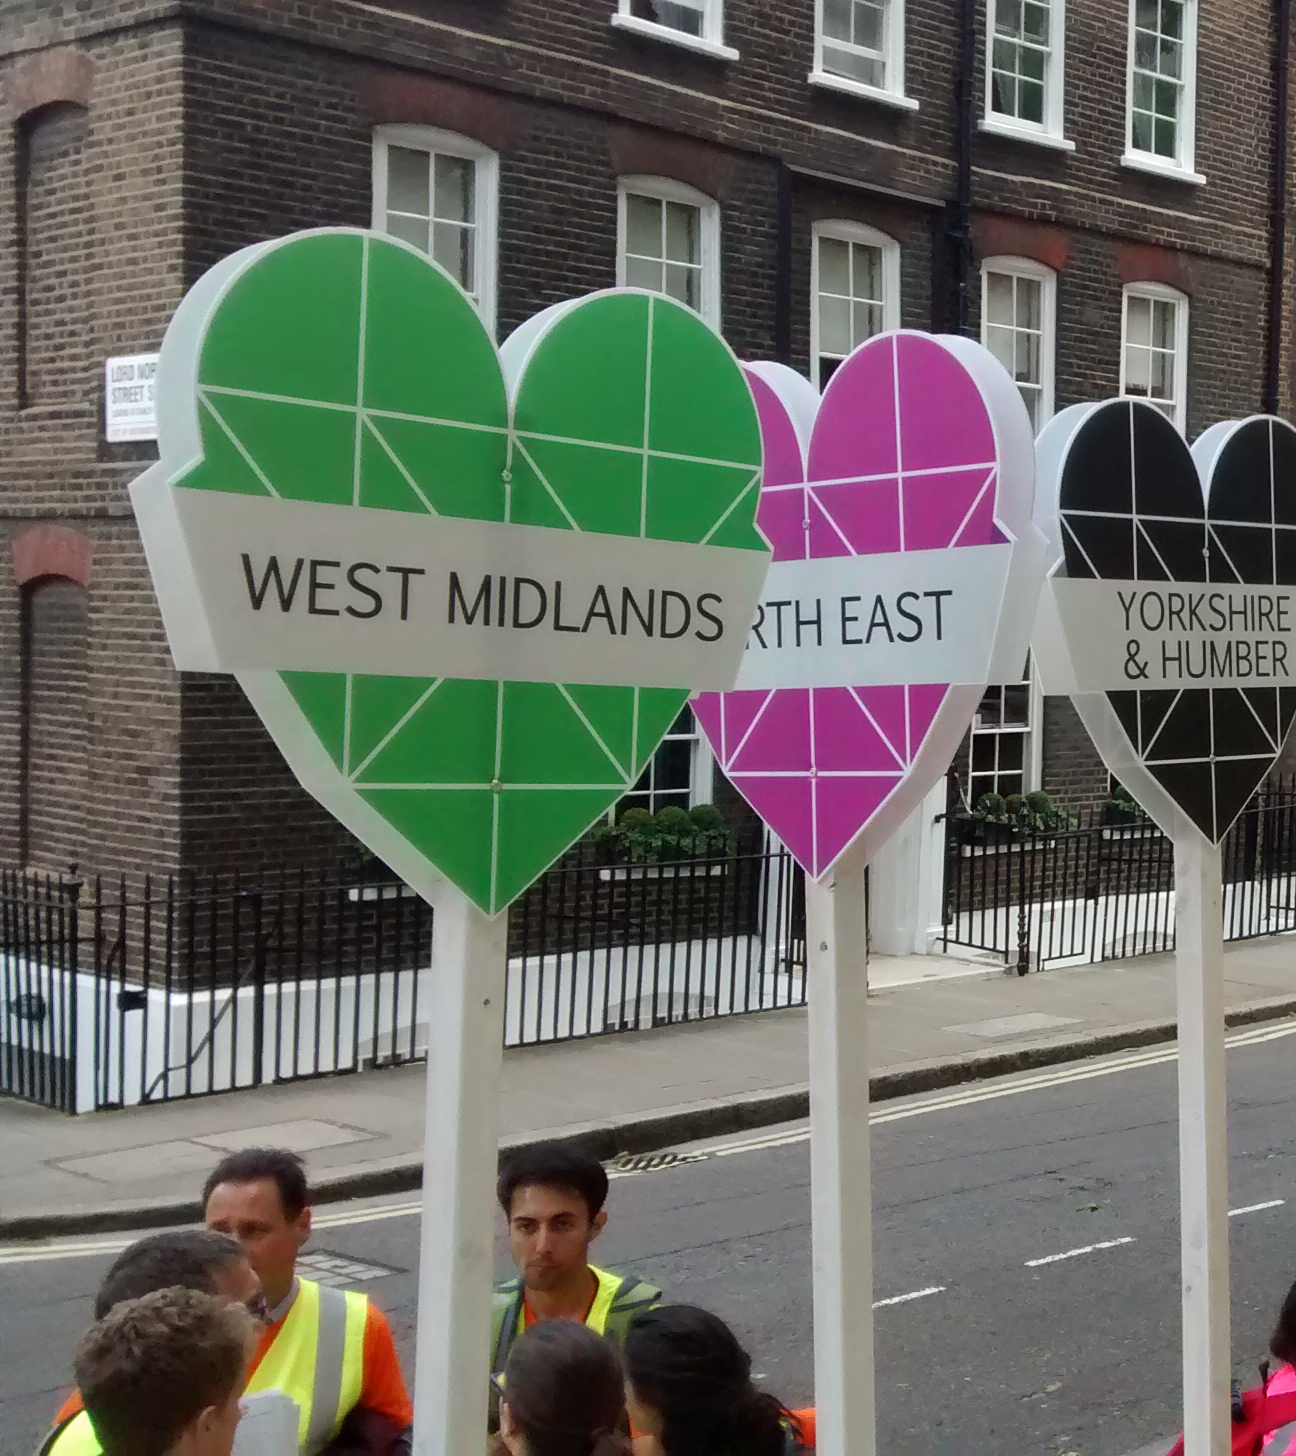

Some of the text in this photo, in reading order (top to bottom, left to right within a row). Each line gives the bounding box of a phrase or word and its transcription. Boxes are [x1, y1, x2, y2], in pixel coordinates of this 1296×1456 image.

[111, 364, 134, 383] LORD
[111, 385, 144, 405] STREET
[240, 552, 725, 643] WEST MIDLANDS
[840, 589, 953, 645] EAST
[1117, 590, 1292, 632] YORKSHIRE
[1123, 638, 1290, 680] & HUMBER
